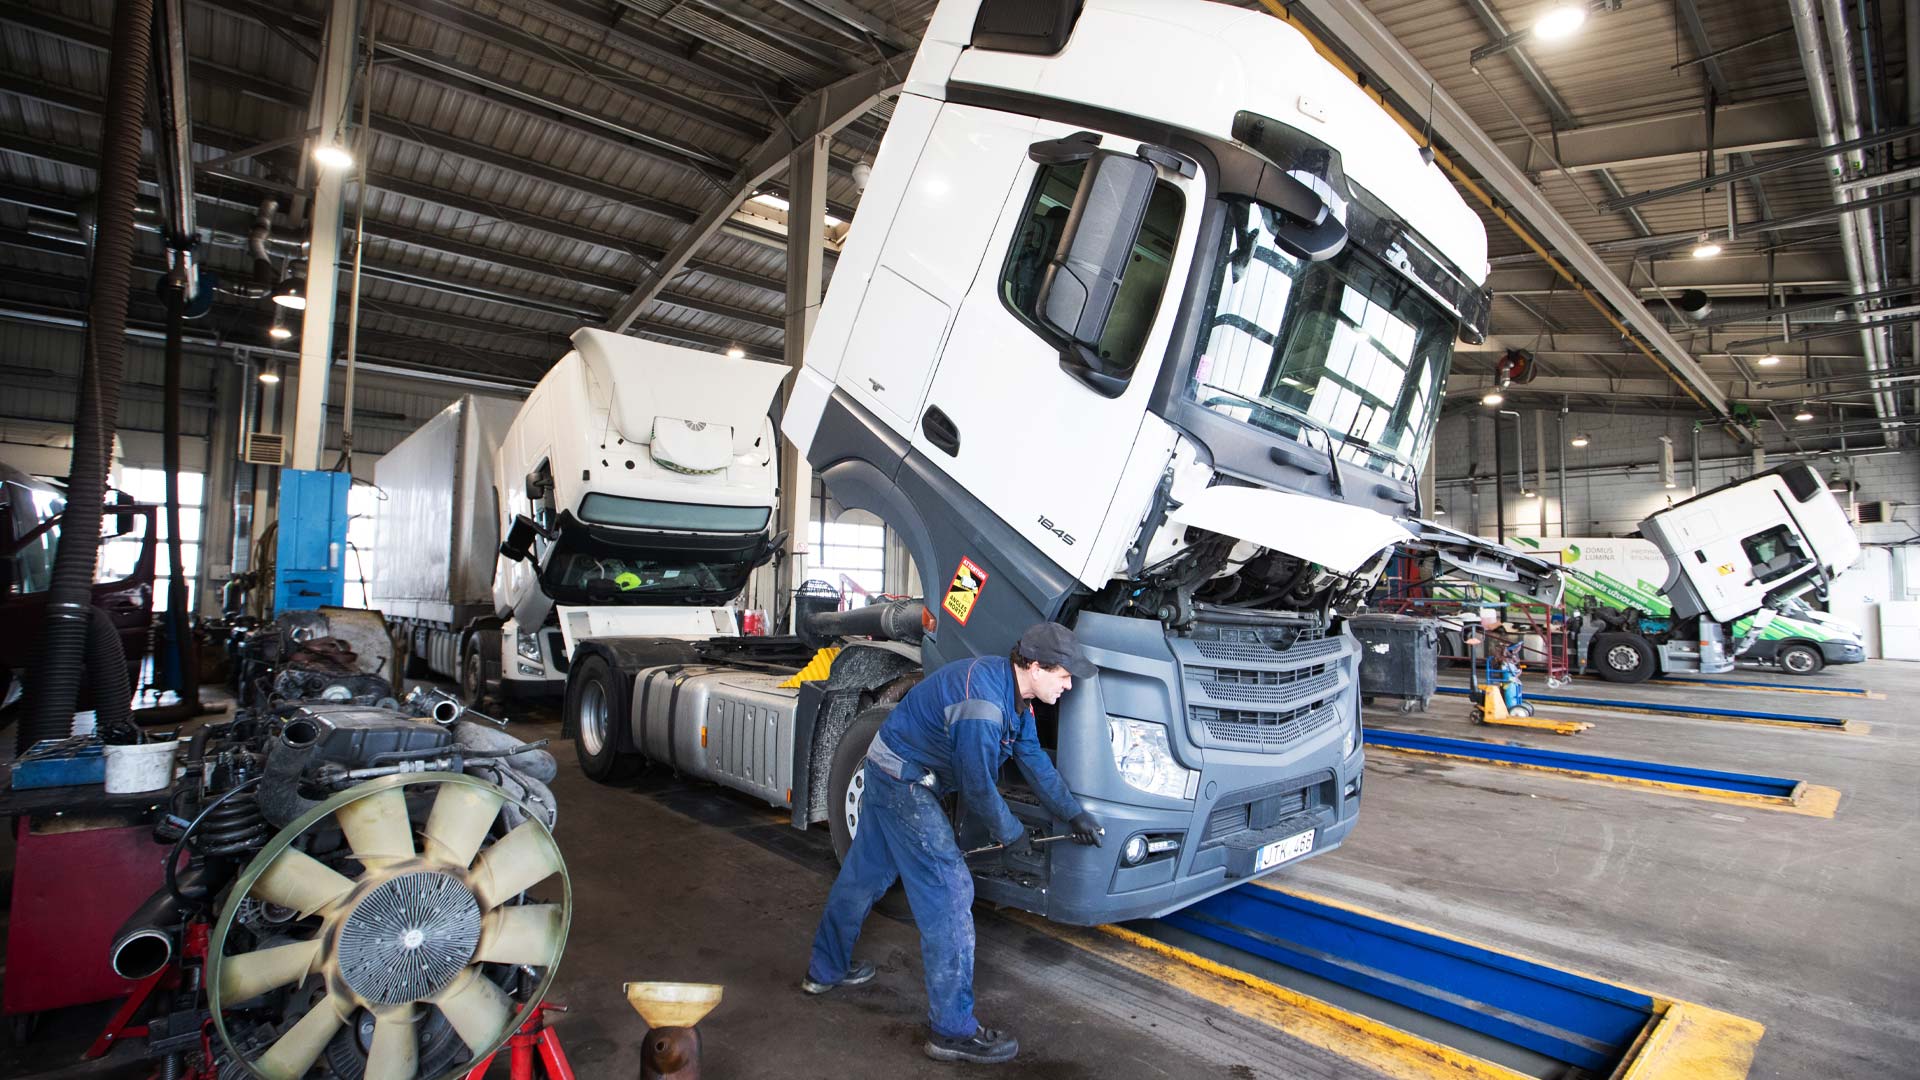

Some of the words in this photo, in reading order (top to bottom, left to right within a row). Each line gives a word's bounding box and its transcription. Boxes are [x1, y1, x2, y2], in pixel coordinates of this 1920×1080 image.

[1037, 514, 1076, 545] 1845
[963, 559, 986, 580] ATTENTION
[948, 601, 964, 617] MORTS
[949, 595, 968, 612] ANGLES
